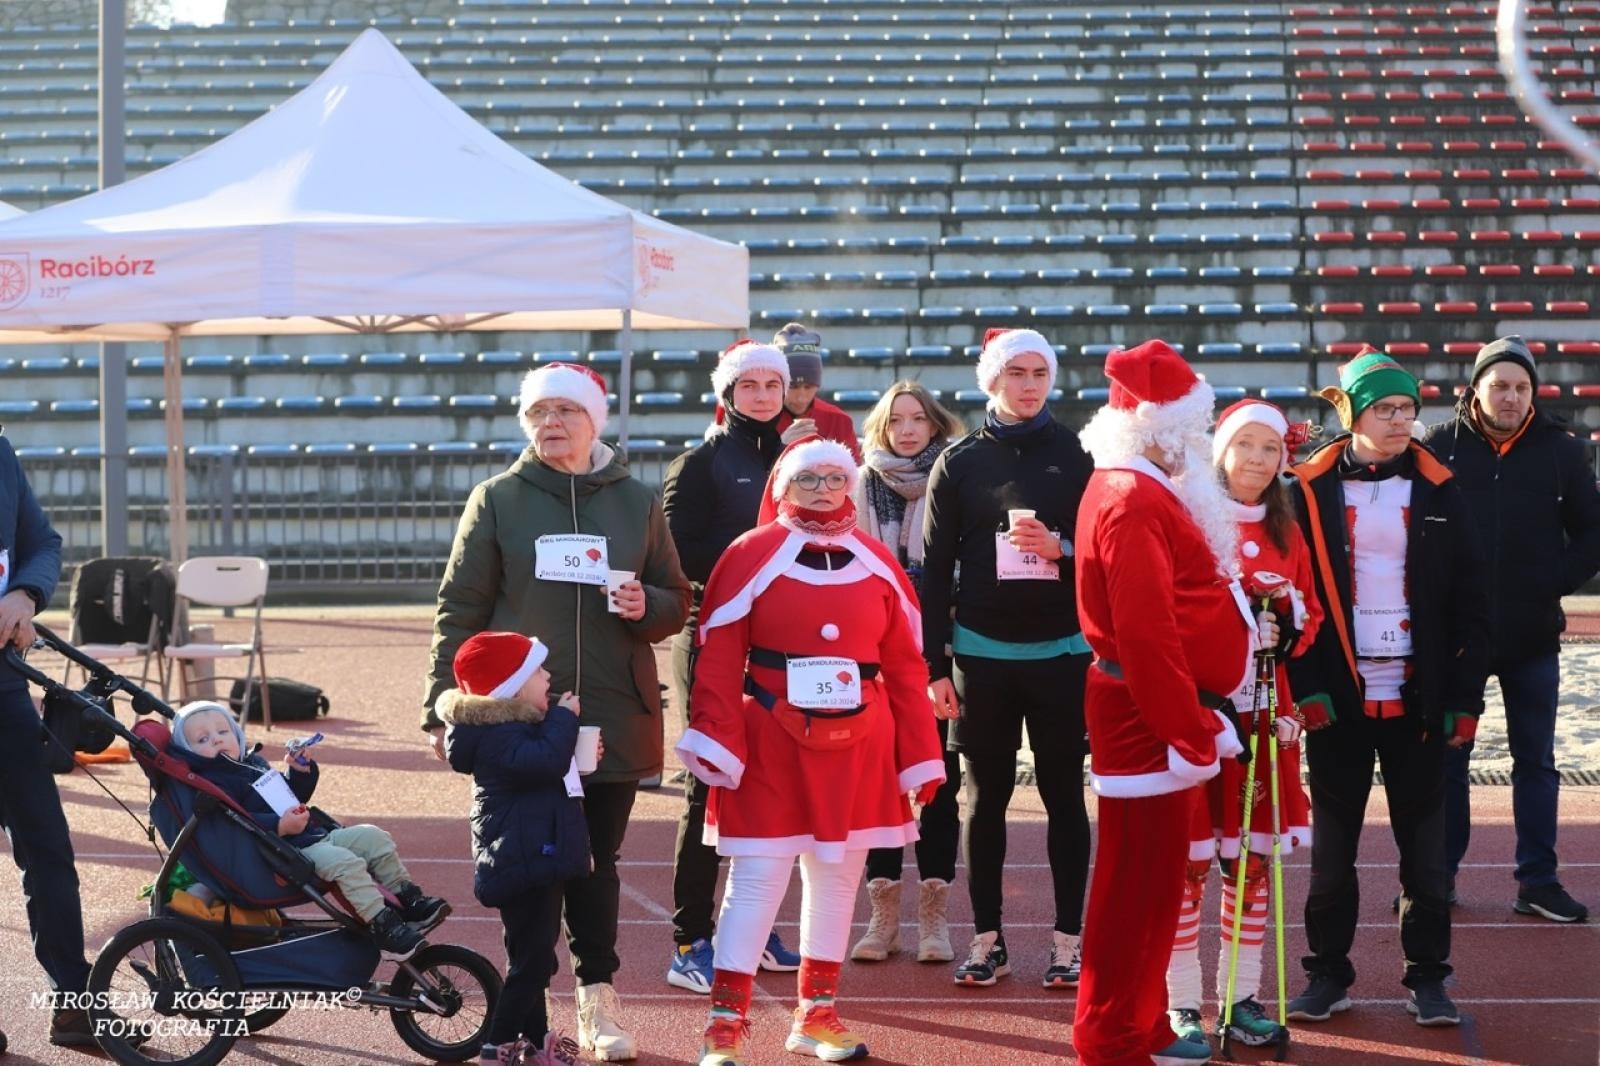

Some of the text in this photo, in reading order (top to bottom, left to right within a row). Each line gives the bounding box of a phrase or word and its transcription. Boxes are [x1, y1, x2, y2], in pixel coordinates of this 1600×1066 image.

[40, 254, 156, 279] Racibórz
[40, 286, 71, 299] 1217
[564, 555, 581, 568] 50
[1023, 555, 1037, 565] 44
[1380, 630, 1396, 642] 41
[816, 681, 833, 695] 35
[1240, 684, 1255, 697] 42
